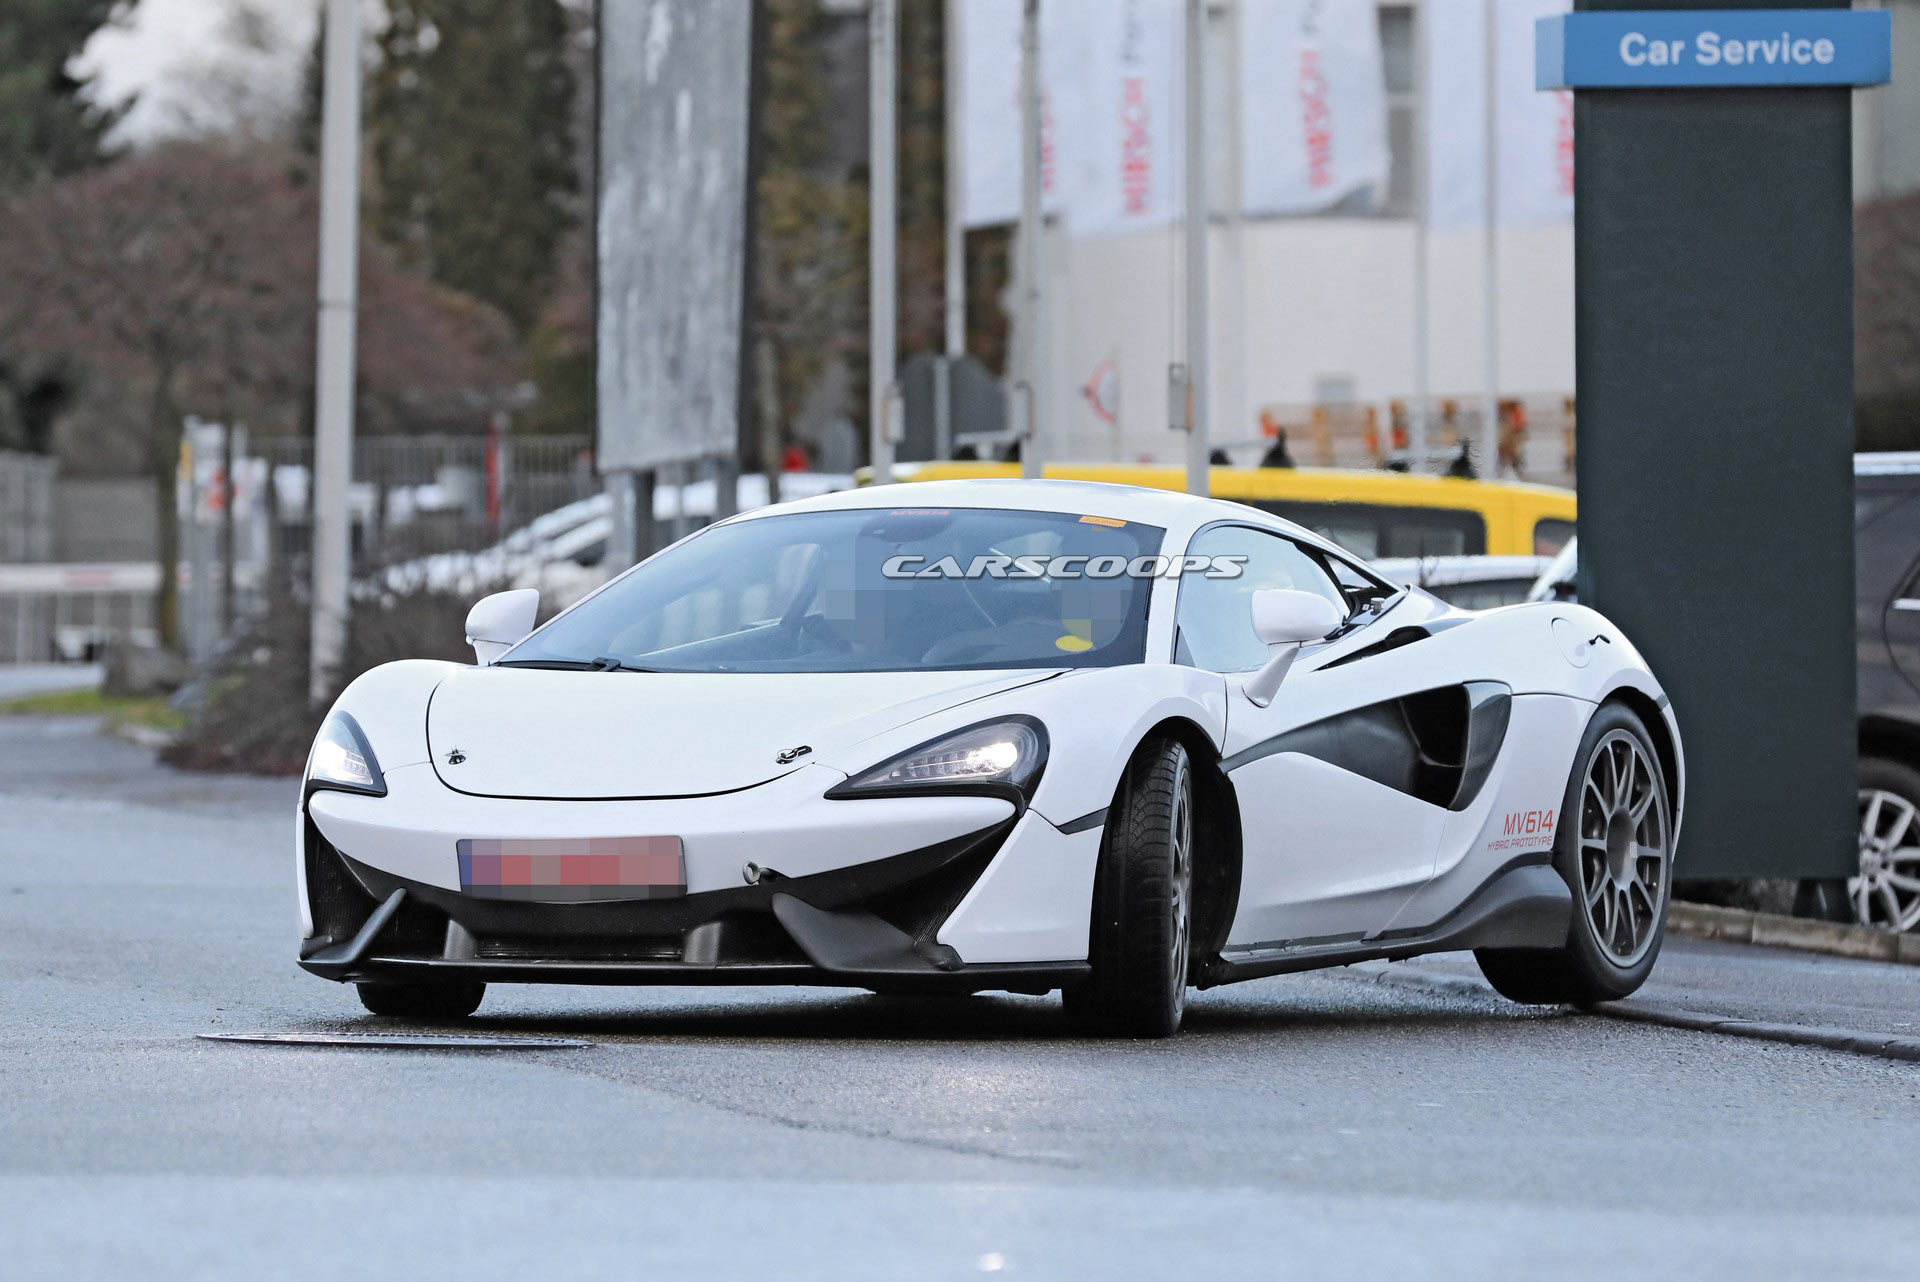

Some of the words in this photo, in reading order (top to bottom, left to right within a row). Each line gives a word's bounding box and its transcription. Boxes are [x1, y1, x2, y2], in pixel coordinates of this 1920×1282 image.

[1619, 31, 1685, 66] Car
[1695, 31, 1835, 66] Service
[1503, 810, 1553, 835] MV614
[1487, 839, 1509, 851] HYBRID
[1510, 836, 1552, 848] PROTOTYPE
